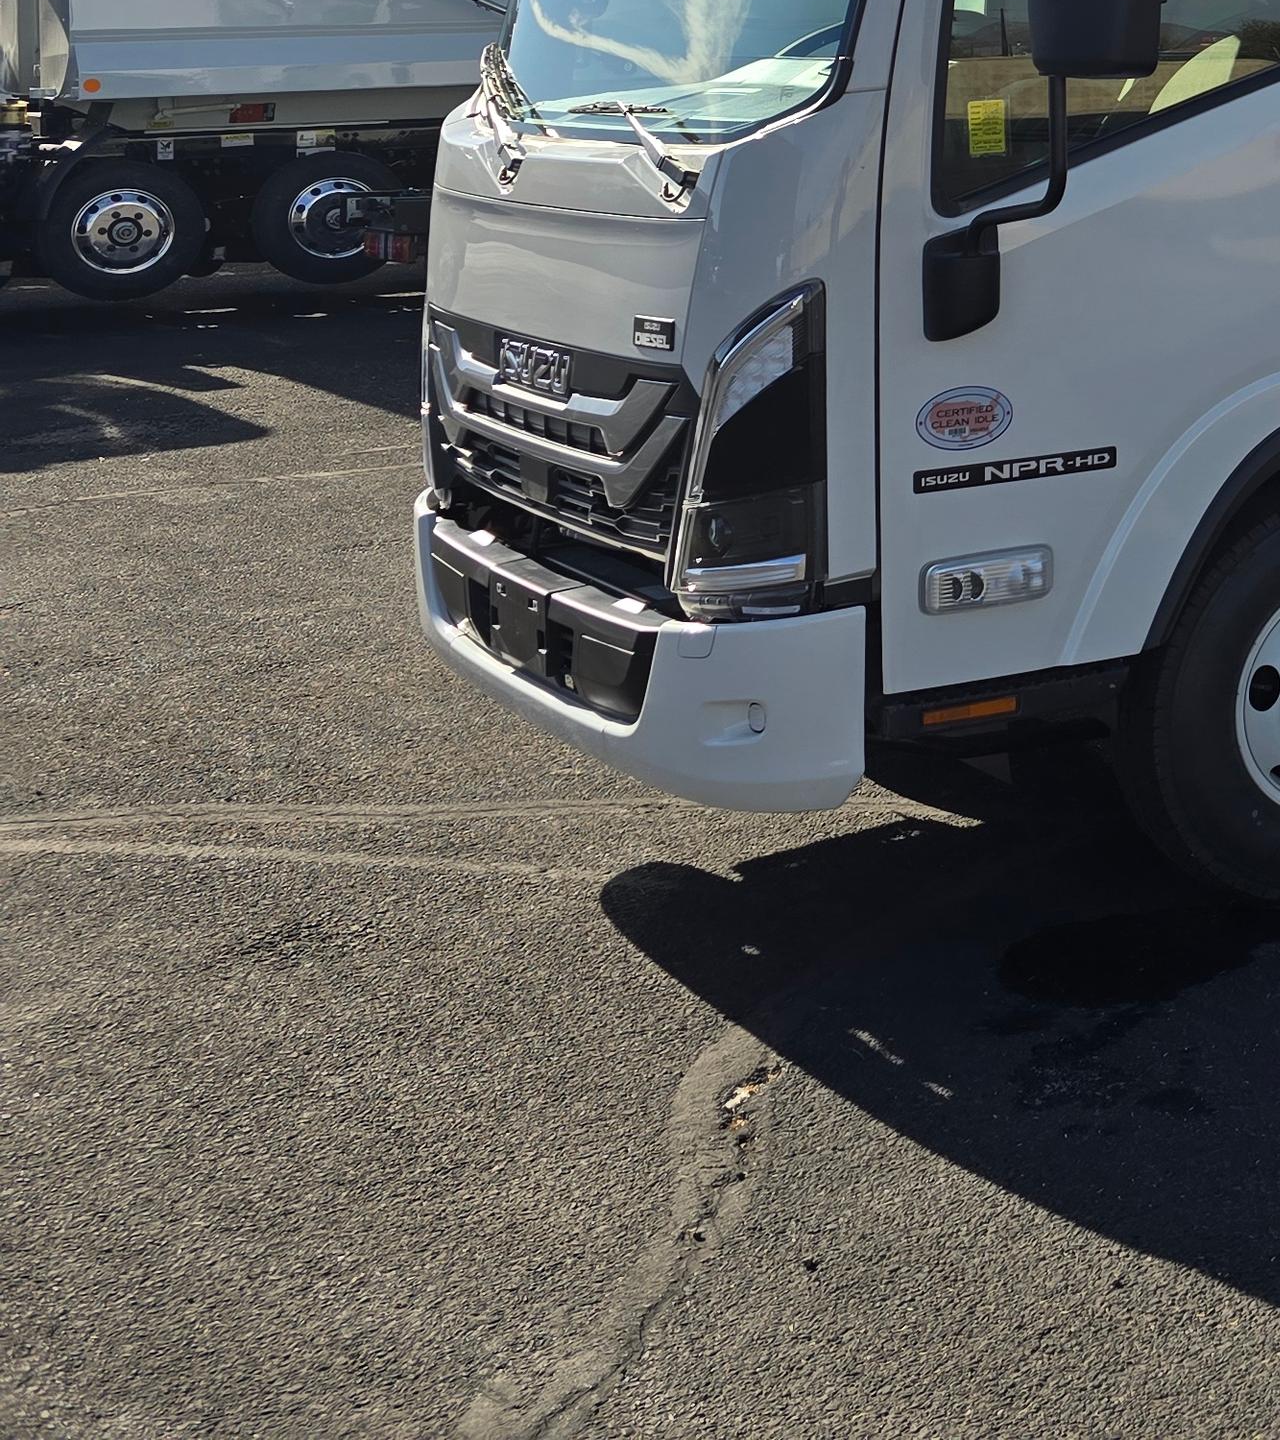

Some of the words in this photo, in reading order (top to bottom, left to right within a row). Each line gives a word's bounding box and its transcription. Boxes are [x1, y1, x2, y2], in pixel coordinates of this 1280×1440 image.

[634, 331, 670, 350] DIESEL
[500, 339, 570, 395] ISUZU
[936, 404, 994, 419] CERTIFIED
[931, 417, 970, 430] CLEAN
[975, 413, 1000, 424] IDLE
[921, 471, 970, 488] ISUZU
[984, 452, 1111, 482] NPR-HD
